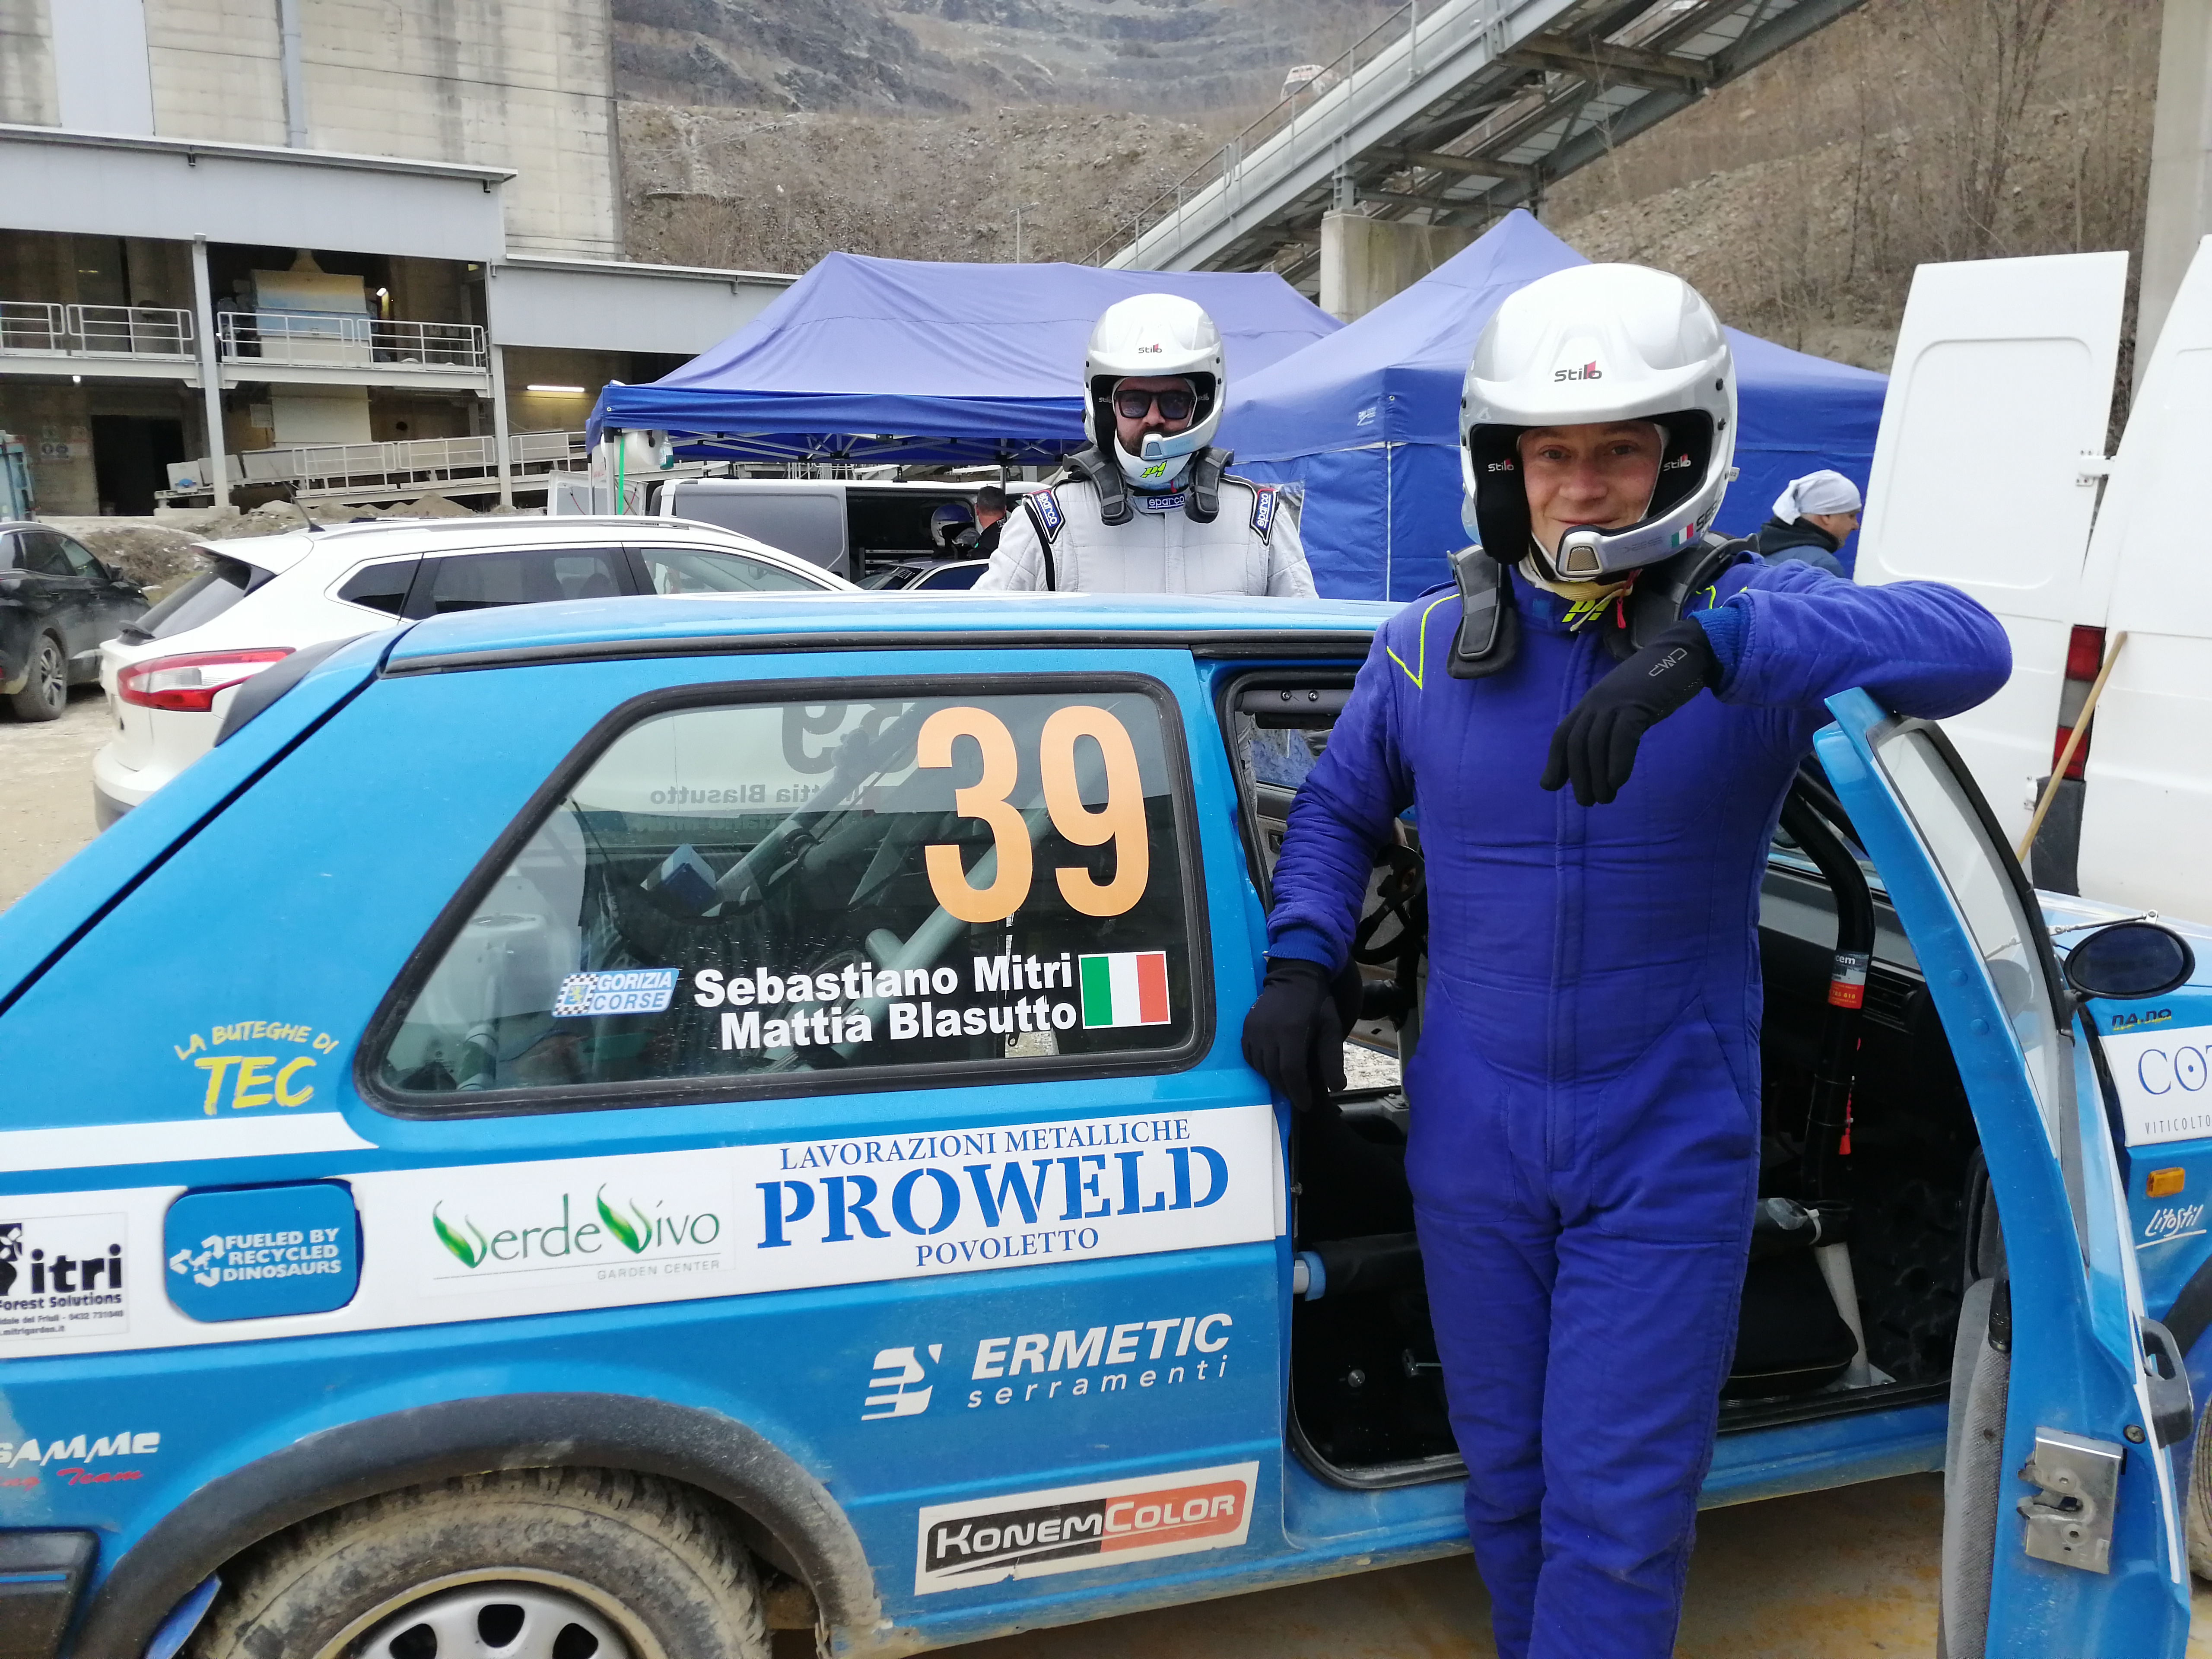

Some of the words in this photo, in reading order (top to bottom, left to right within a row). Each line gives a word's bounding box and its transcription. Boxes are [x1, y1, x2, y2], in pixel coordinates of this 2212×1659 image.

[1138, 343, 1162, 354] Stilo
[1554, 360, 1602, 382] Stilo
[1487, 458, 1514, 472] Stilo
[1663, 454, 1691, 471] Stilo
[1037, 493, 1058, 526] sparco
[1149, 496, 1185, 509] sparco
[1256, 493, 1270, 527] sparco
[1648, 648, 1688, 677] CMP
[916, 704, 1150, 923] 39
[597, 971, 672, 991] GORIZIA
[694, 961, 960, 1009] Sebastiano
[974, 952, 1073, 995] Mitri
[593, 992, 667, 1011] CORSE
[721, 1006, 873, 1051] Mattia
[889, 995, 1077, 1040] Blasutto
[174, 1033, 207, 1061] LA
[212, 1021, 312, 1045] BUTEGHE
[312, 1033, 340, 1054] DI
[2138, 1044, 2212, 1095] CO
[194, 1055, 317, 1116] TEC
[2145, 1115, 2211, 1135] VITICOLTO
[780, 1132, 997, 1171] LAVORAZIONI
[1004, 1117, 1191, 1154] METALLICHE
[756, 1145, 1229, 1249] PROWELD
[225, 1230, 304, 1250] FUELED
[309, 1228, 340, 1244] BY
[915, 1227, 1099, 1268] POVOLETTO
[228, 1244, 339, 1266] RECYCLED
[222, 1259, 343, 1282] DINOSAURS
[597, 1265, 658, 1281] GARDEN
[664, 1259, 720, 1274] CENTER
[49, 1292, 122, 1308] Solutions
[971, 1313, 1233, 1381] ERMETIC
[966, 1354, 1229, 1409] serramenti
[56, 1467, 144, 1486] Team
